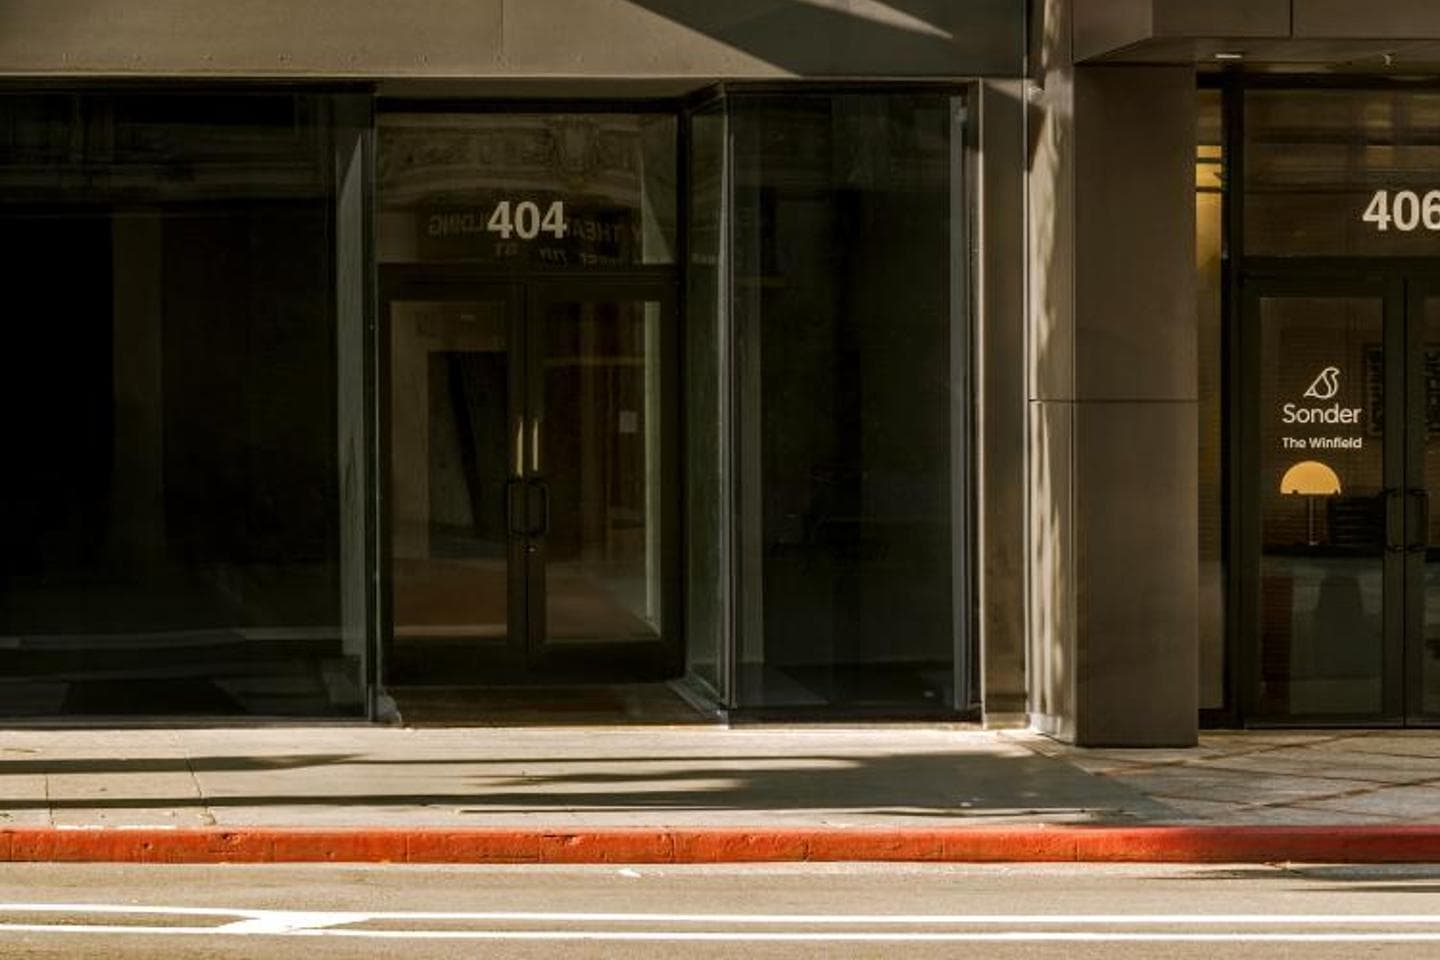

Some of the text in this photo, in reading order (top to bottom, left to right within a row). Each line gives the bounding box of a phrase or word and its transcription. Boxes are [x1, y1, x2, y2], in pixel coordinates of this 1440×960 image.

[487, 200, 568, 240] 404
[1282, 403, 1362, 424] Sonder
[1282, 437, 1363, 449] The Winfield
